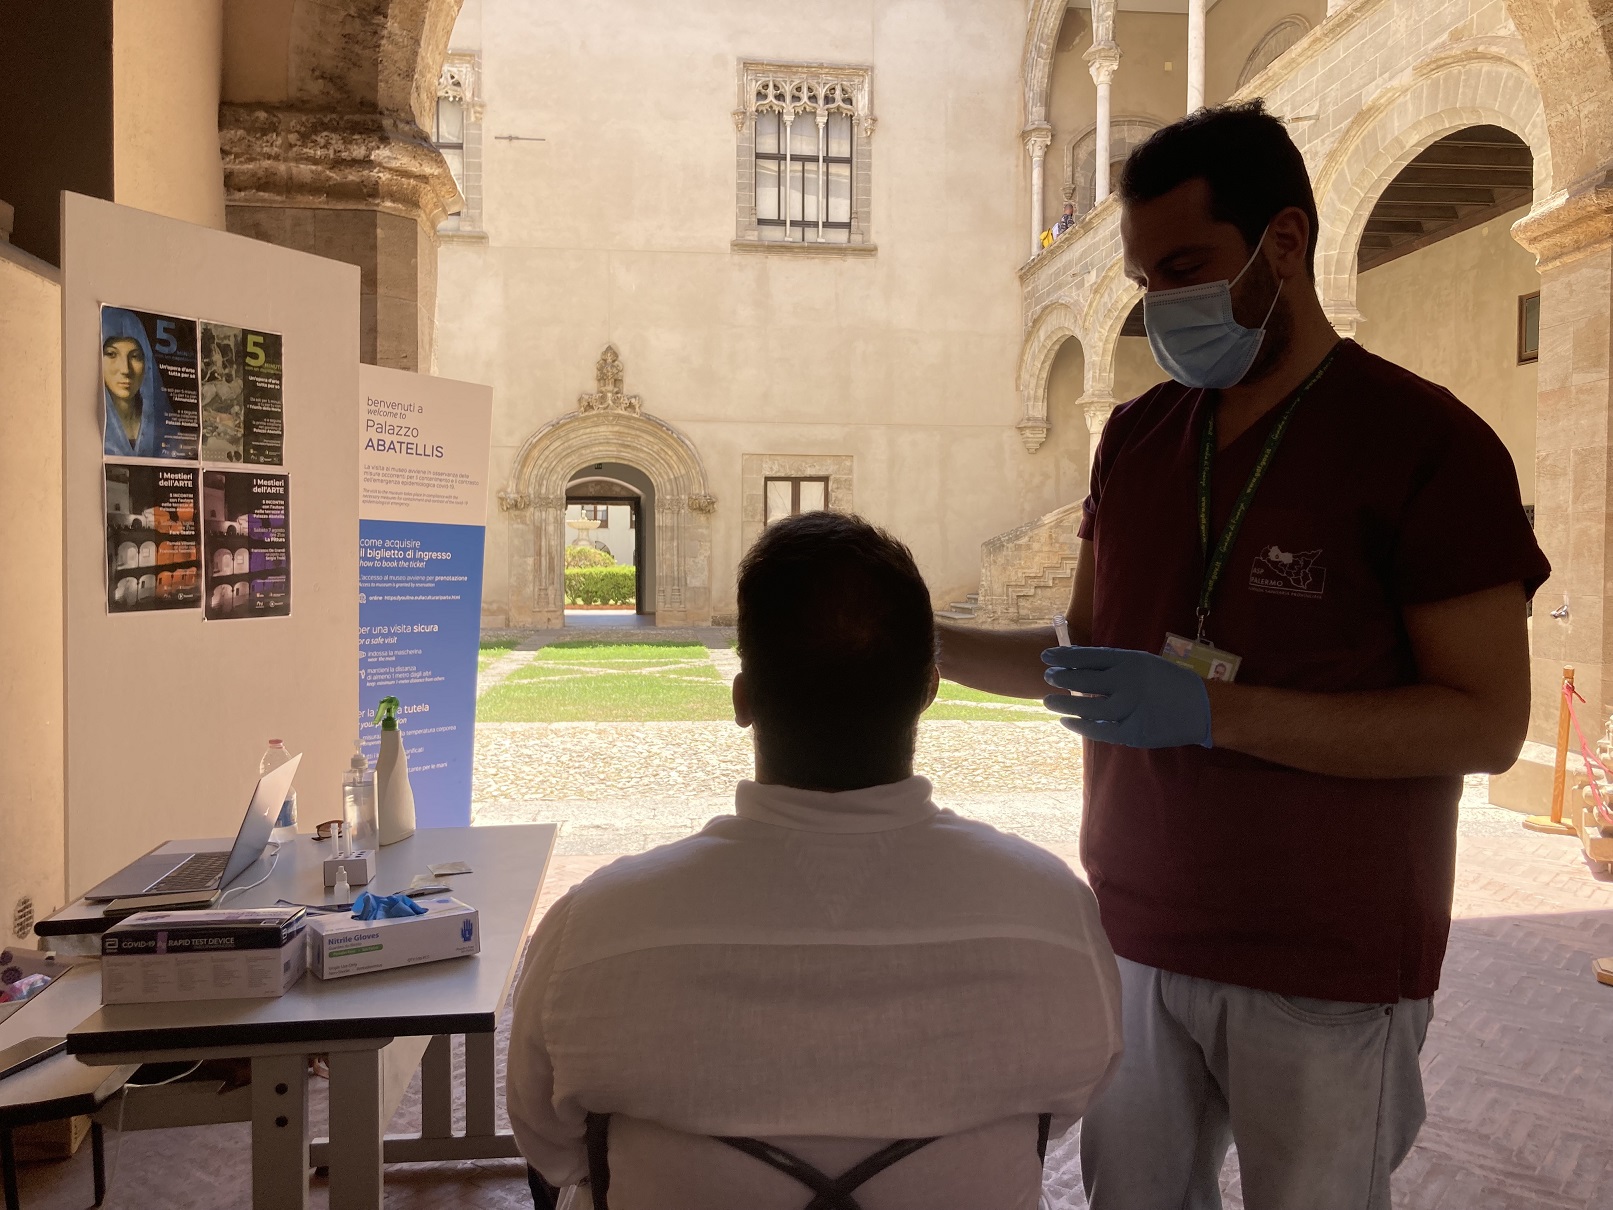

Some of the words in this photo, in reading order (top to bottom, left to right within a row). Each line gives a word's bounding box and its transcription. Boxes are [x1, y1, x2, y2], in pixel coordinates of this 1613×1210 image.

[155, 320, 178, 354] 5
[246, 334, 265, 367] 5
[367, 396, 415, 412] benvenuti
[418, 405, 423, 414] a
[367, 408, 398, 419] welcome
[400, 412, 407, 420] to
[366, 419, 419, 438] Palazzo
[365, 438, 444, 458] ABATELLIS
[164, 472, 193, 480] Mestieri
[419, 476, 450, 484] contenimento
[159, 480, 193, 488] dell'ARTE
[364, 477, 400, 485] dell'emergenza
[401, 480, 436, 489] epidemiologica
[253, 486, 284, 494] dell'ARTE
[360, 538, 382, 547] come
[384, 538, 421, 550] acquisire
[361, 548, 365, 558] il
[367, 548, 404, 560] biglietto
[406, 549, 414, 559] di
[415, 550, 452, 561] ingresso
[360, 559, 373, 568] how
[374, 560, 381, 568] to
[382, 560, 397, 568] book
[398, 560, 409, 568] the
[410, 560, 426, 568] ticket
[1252, 567, 1265, 575] ASP
[1251, 576, 1284, 587] PALERMO
[372, 626, 388, 635] una
[390, 624, 411, 634] visita
[413, 624, 439, 633] sicura
[371, 636, 384, 645] safe
[385, 636, 397, 644] visit
[368, 708, 375, 718] la
[404, 703, 430, 714] tutela
[407, 727, 434, 735] temperatura
[122, 940, 156, 949] COVID-19
[209, 937, 235, 945] DEVICE
[328, 936, 353, 945] Nitrile
[353, 932, 380, 942] Gloves
